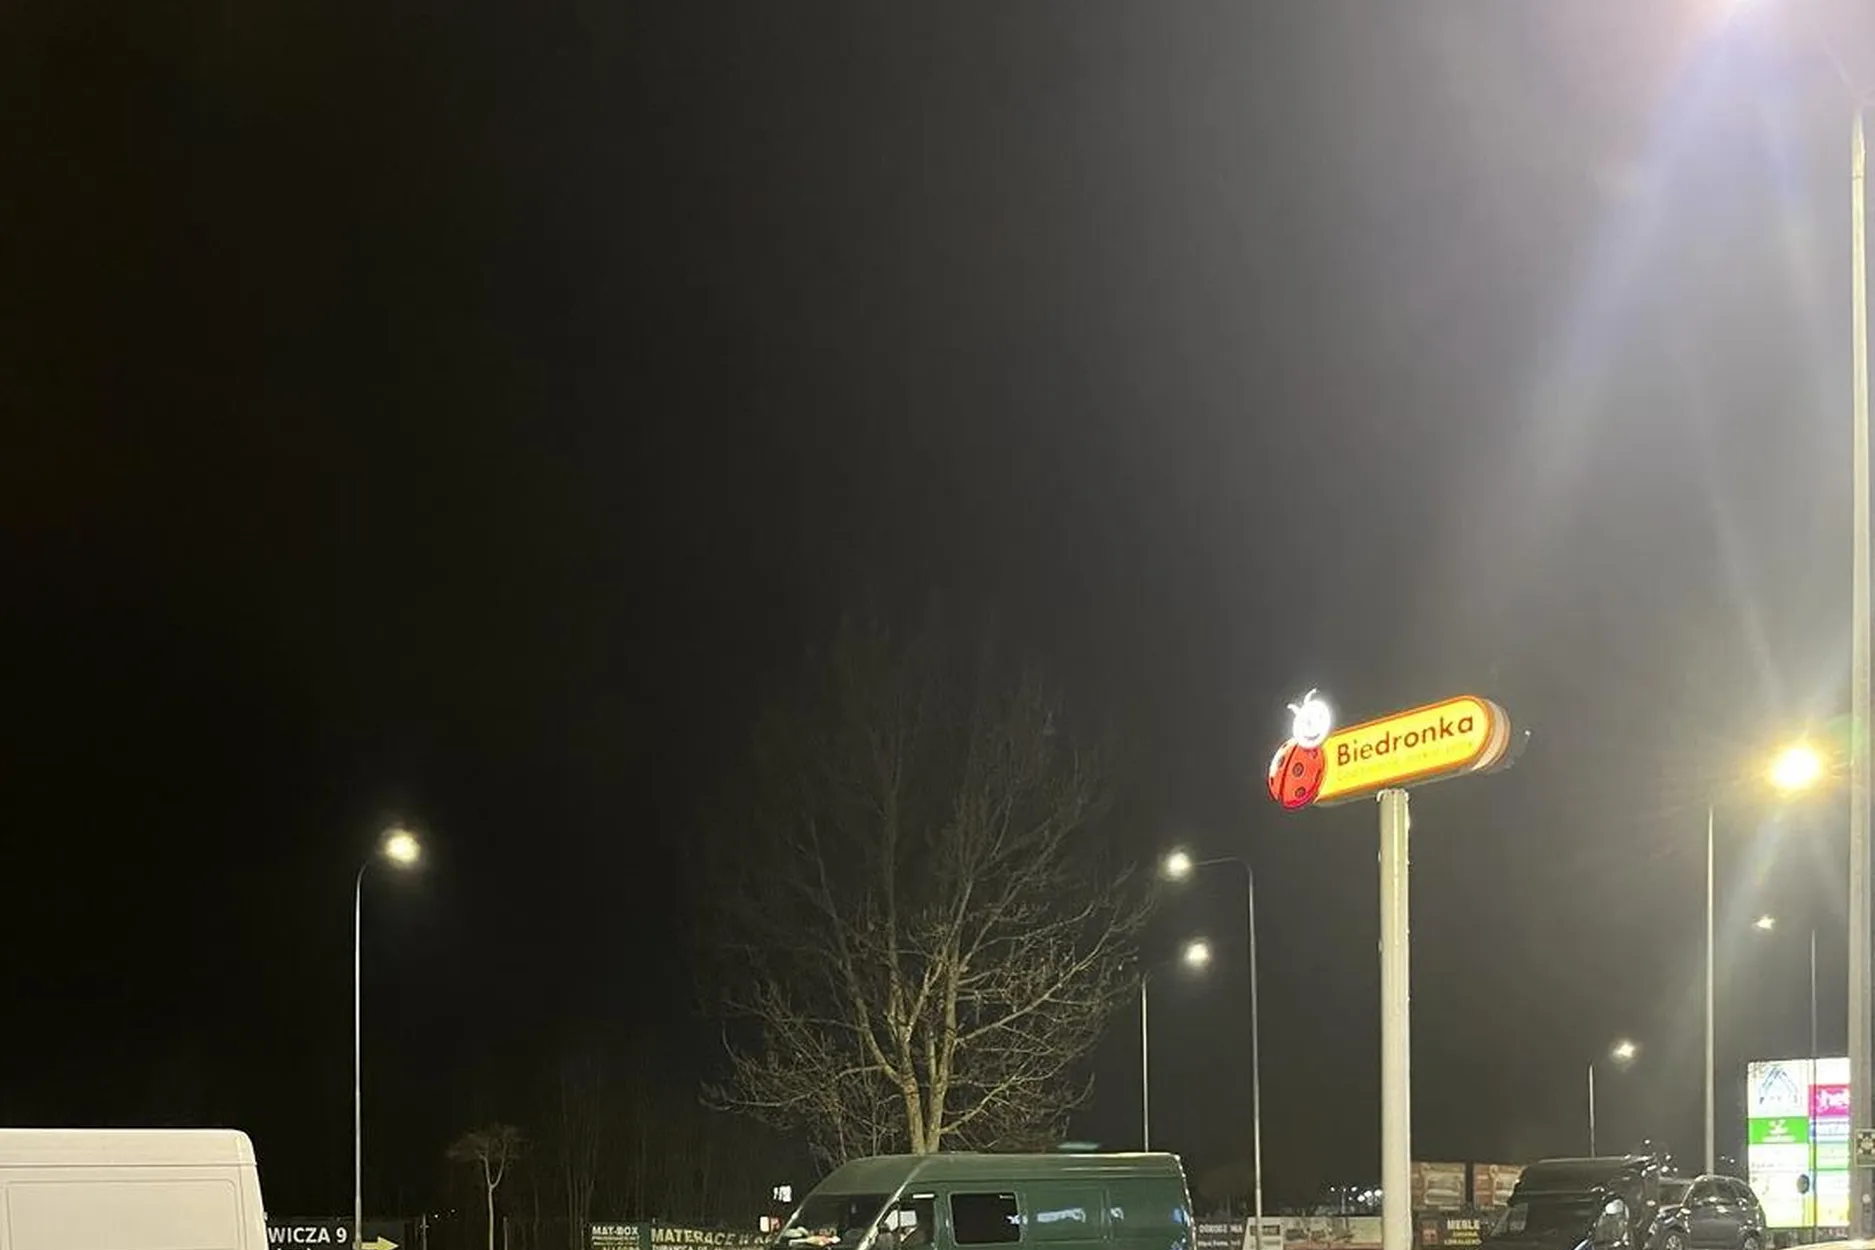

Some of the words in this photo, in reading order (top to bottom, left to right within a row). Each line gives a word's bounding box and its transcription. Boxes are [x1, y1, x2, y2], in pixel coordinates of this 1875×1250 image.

[1337, 715, 1474, 767] Biedronka
[335, 1226, 348, 1244] 9
[651, 1228, 737, 1246] MATERACE
